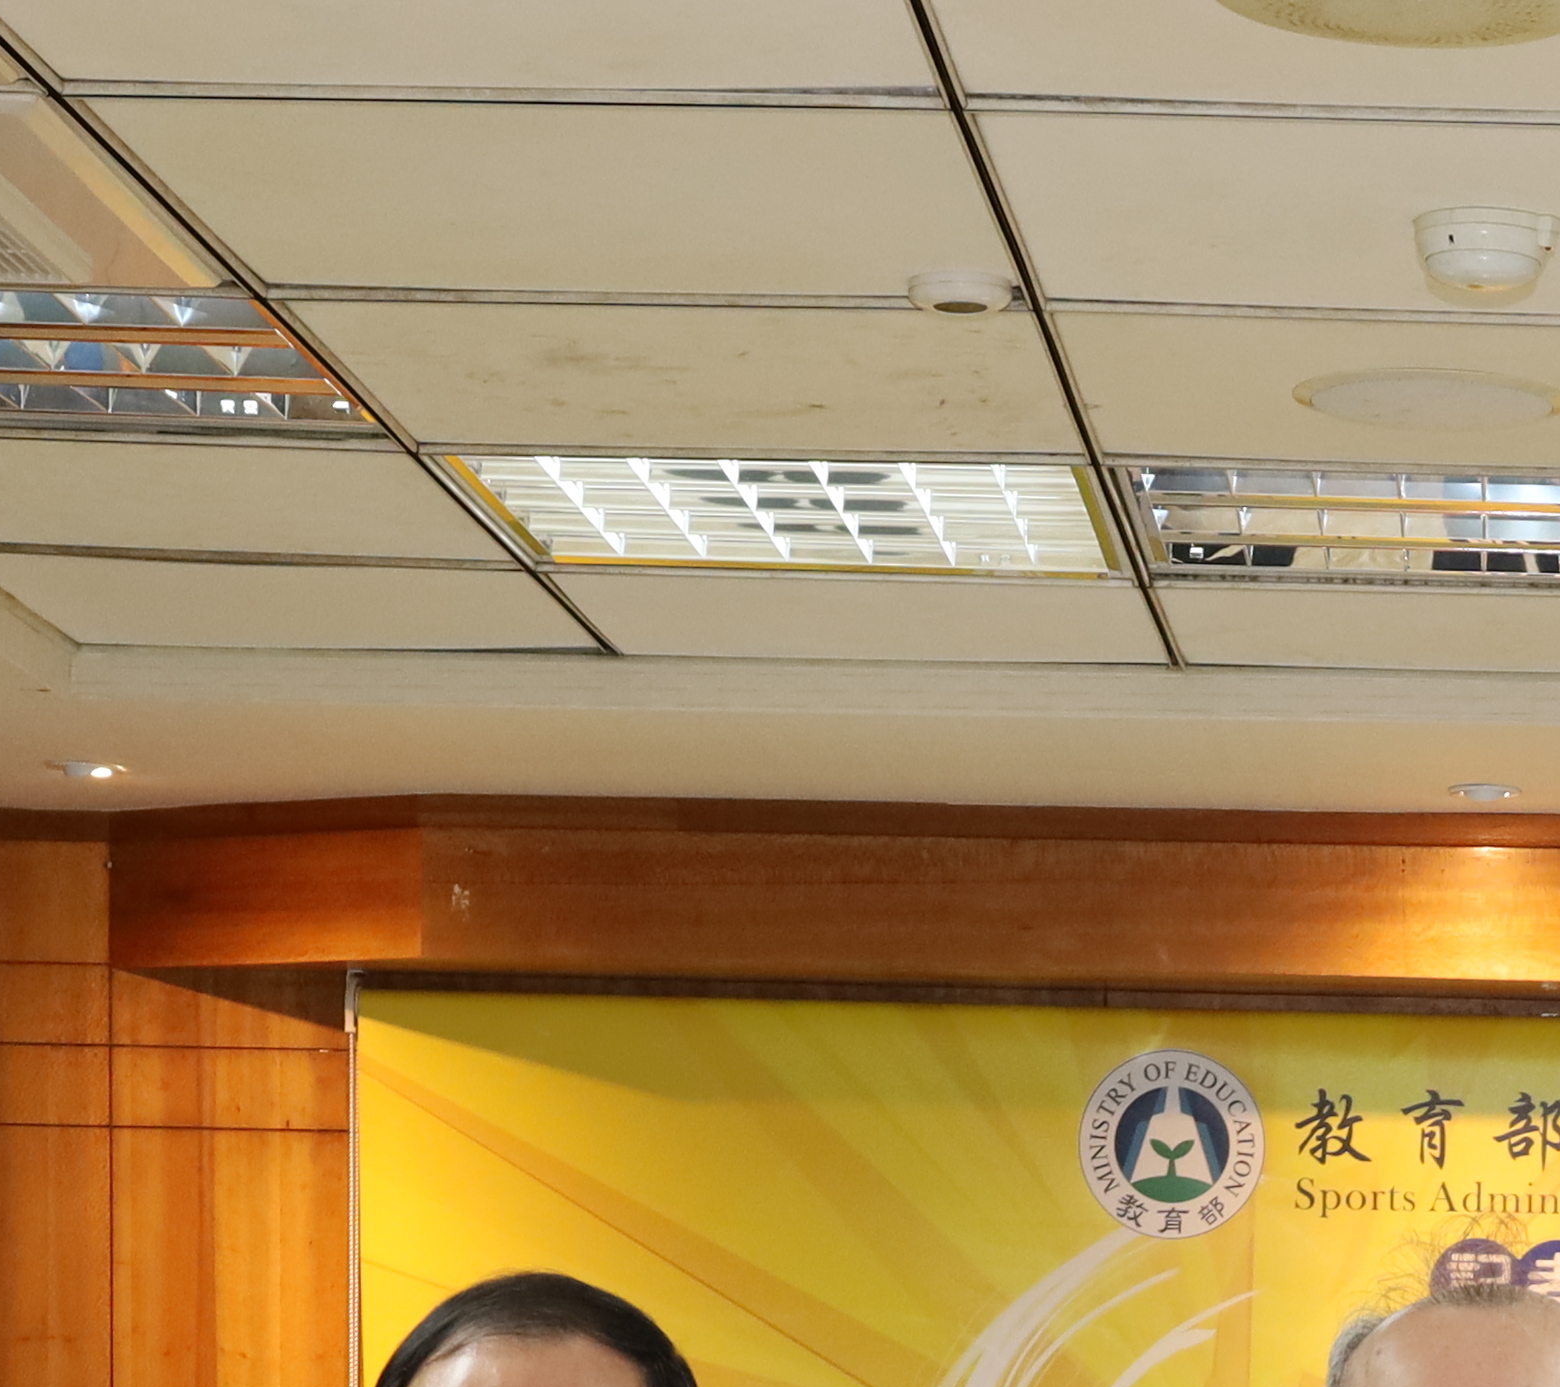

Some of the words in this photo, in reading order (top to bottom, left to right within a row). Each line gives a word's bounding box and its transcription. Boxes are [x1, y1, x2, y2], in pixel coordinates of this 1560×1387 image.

[1089, 1072, 1137, 1195] MINISTRY
[1143, 1061, 1177, 1082] OF
[1184, 1063, 1256, 1198] EDUCATION
[1116, 1193, 1225, 1234] 教育部
[1294, 1177, 1416, 1222] Sports
